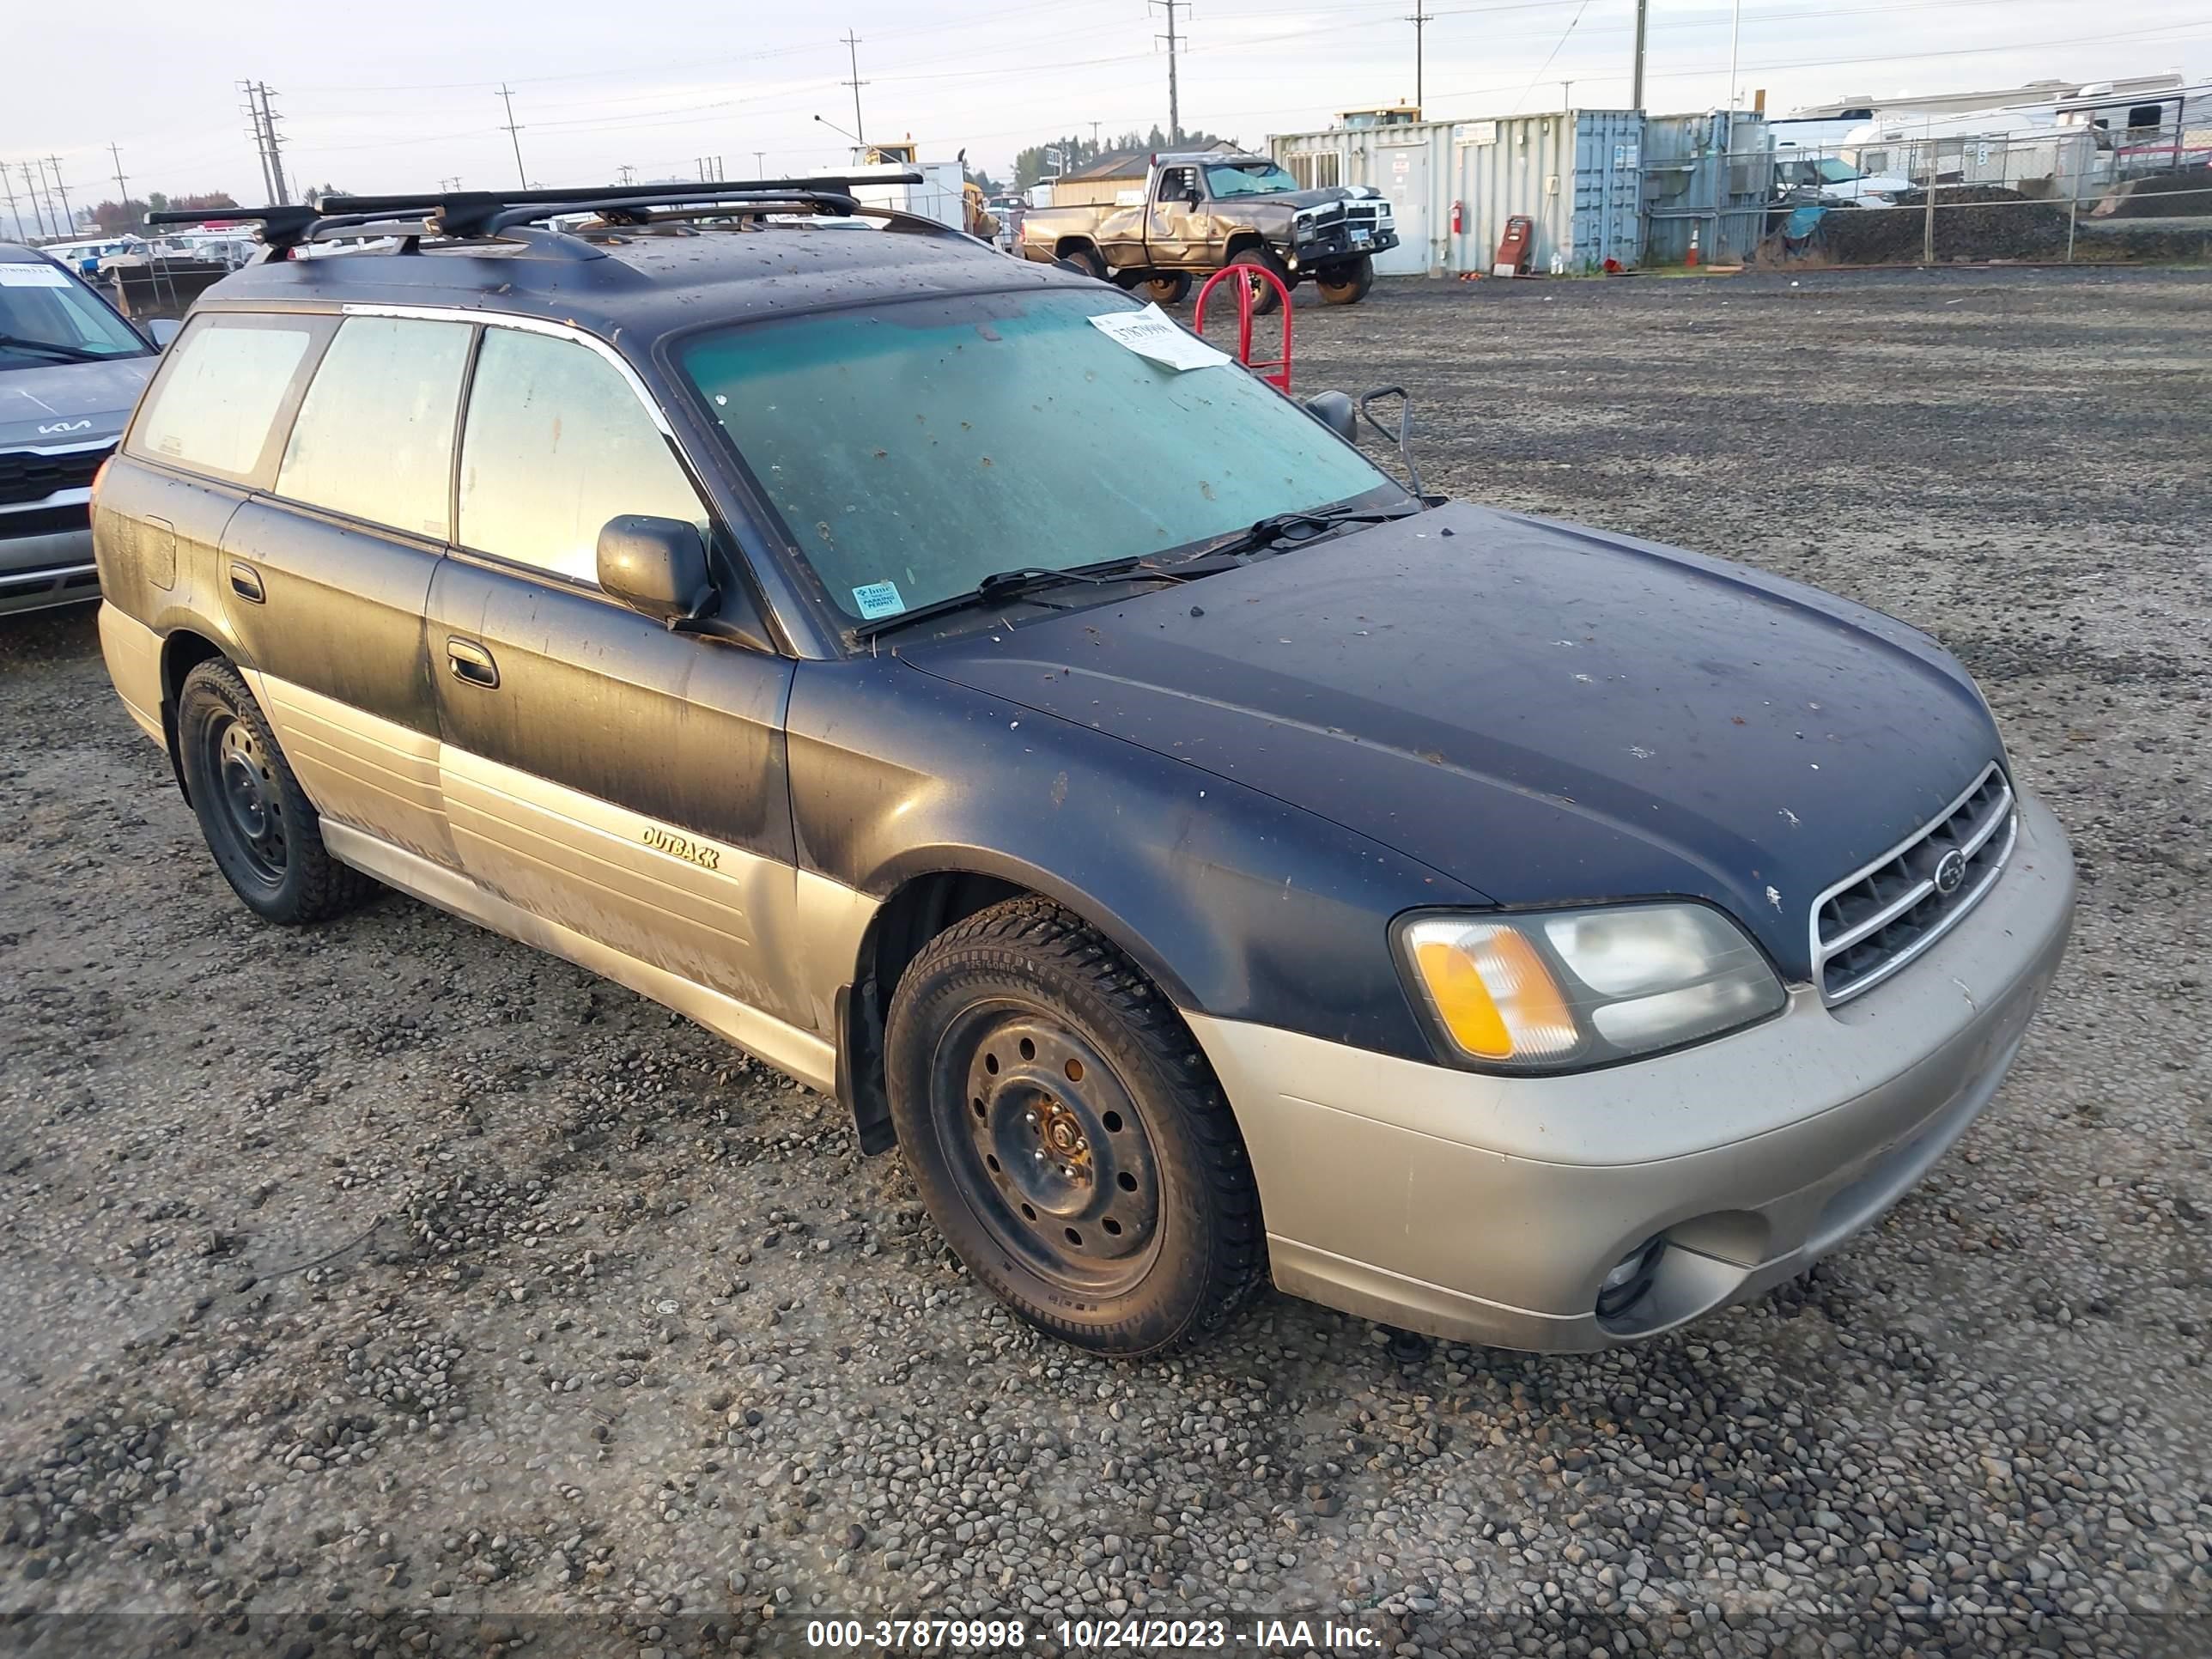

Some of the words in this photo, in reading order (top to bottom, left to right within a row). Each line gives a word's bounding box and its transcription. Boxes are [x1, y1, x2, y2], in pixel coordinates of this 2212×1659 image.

[863, 594, 895, 605] PARKING
[867, 599, 894, 610] PERMIT
[640, 826, 720, 868] OUTBACK
[964, 960, 1018, 974] 225/60R16
